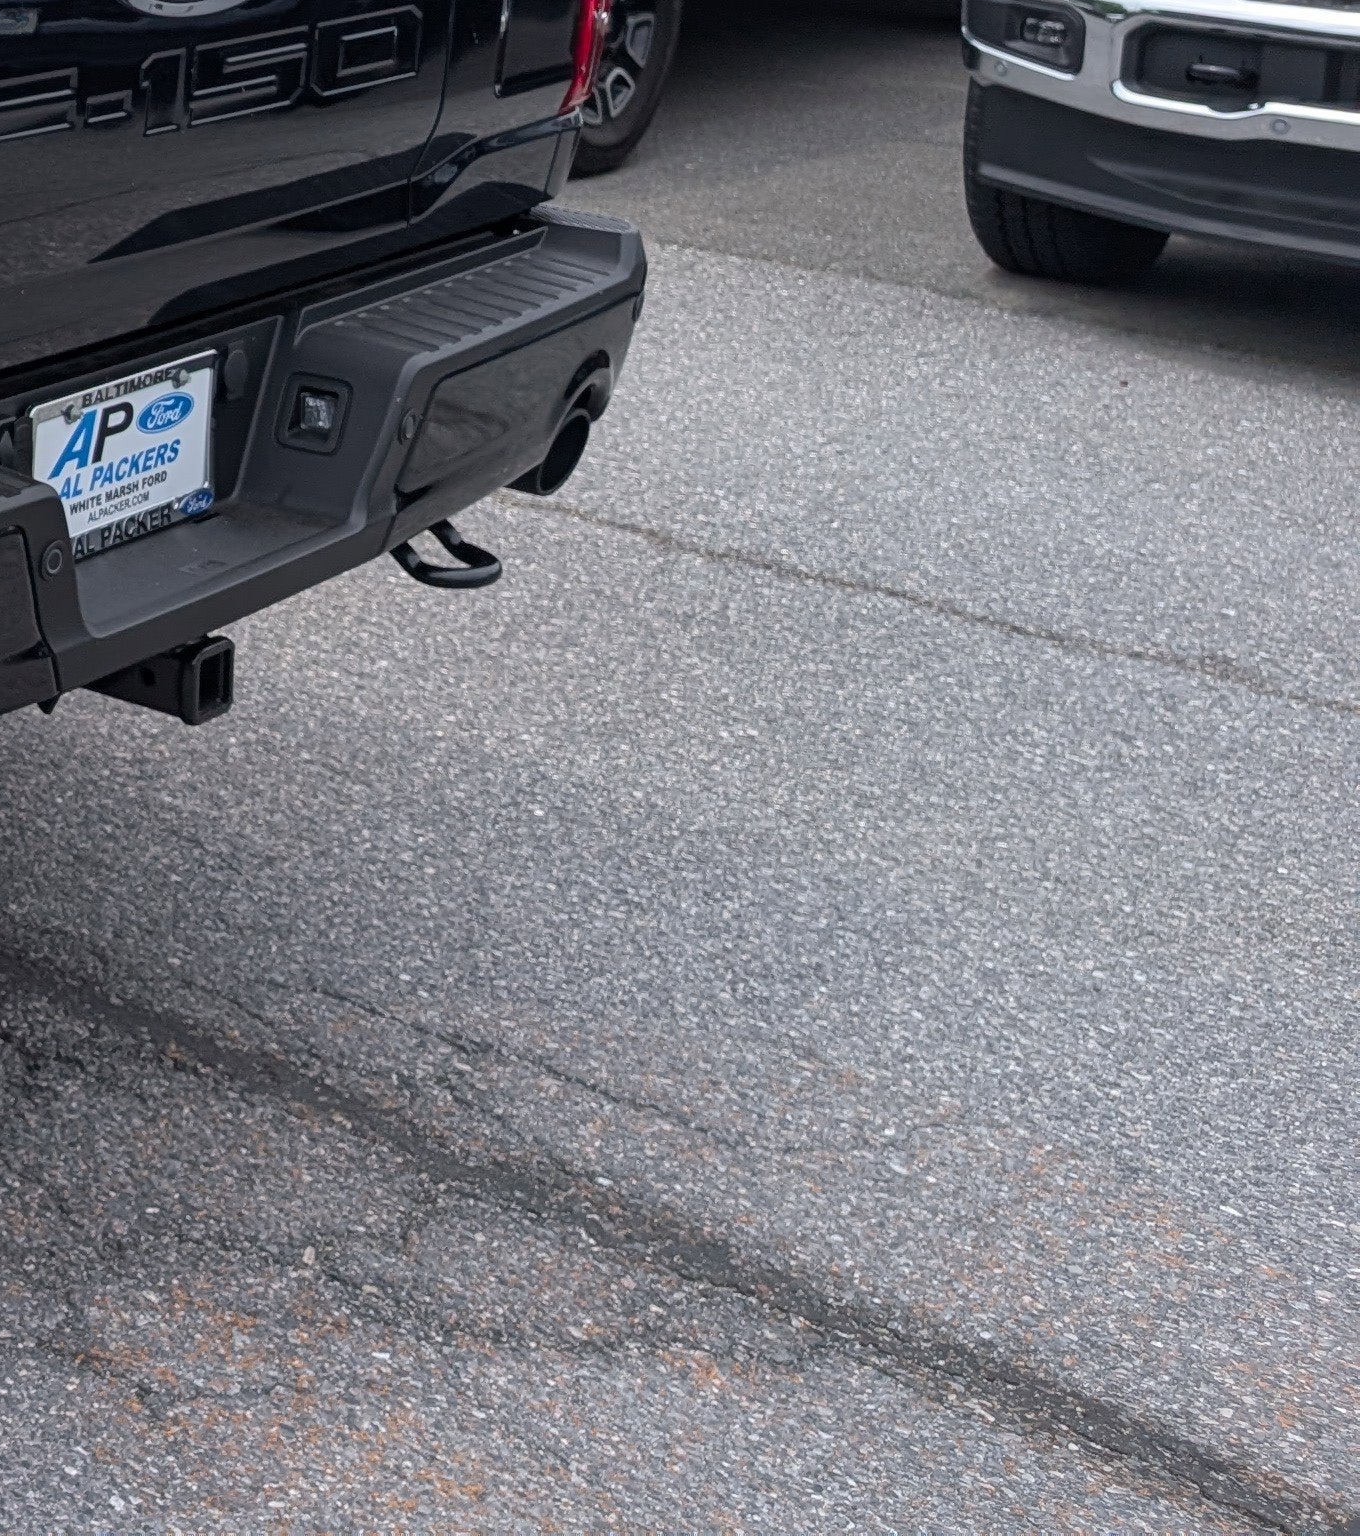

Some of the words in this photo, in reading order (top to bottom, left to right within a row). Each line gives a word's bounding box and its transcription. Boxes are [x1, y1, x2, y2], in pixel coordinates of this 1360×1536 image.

[82, 369, 175, 407] BALTIMORE
[147, 398, 183, 429] Ford
[60, 473, 83, 500] AL
[90, 439, 181, 491] PACKERS
[69, 494, 102, 516] WHITE
[105, 480, 139, 503] MARSH
[142, 470, 168, 491] FORD
[88, 490, 150, 523] ALPACKER.COM
[186, 494, 209, 513] Ford
[73, 532, 96, 557] AL
[101, 503, 172, 549] PACKER
